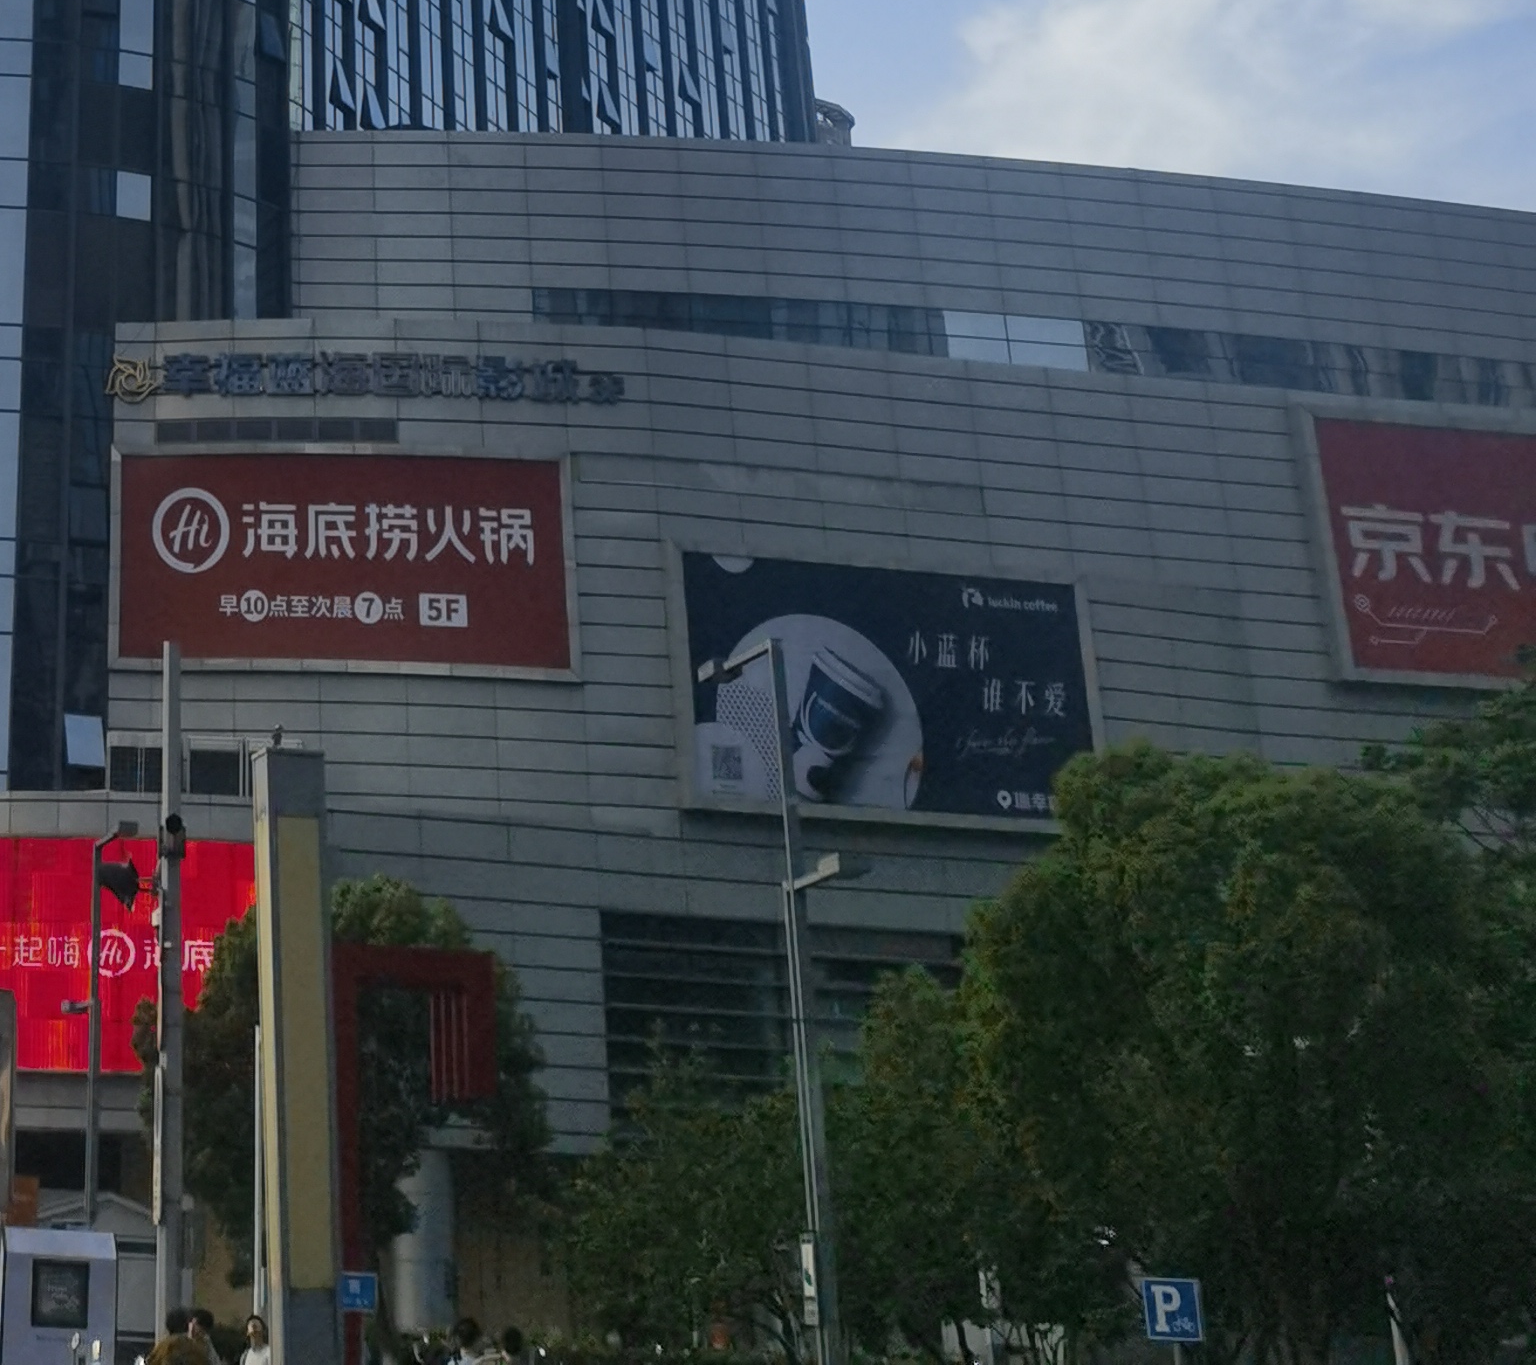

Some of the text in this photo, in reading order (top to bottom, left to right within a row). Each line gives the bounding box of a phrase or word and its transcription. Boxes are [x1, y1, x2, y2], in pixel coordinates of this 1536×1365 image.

[241, 500, 535, 566] 海底捞火锅
[1340, 503, 1536, 592] 京东
[426, 596, 461, 622] 5F
[908, 630, 990, 670] 小蓝杯
[982, 678, 1066, 717] 谁不爱
[1150, 1284, 1182, 1333] P
